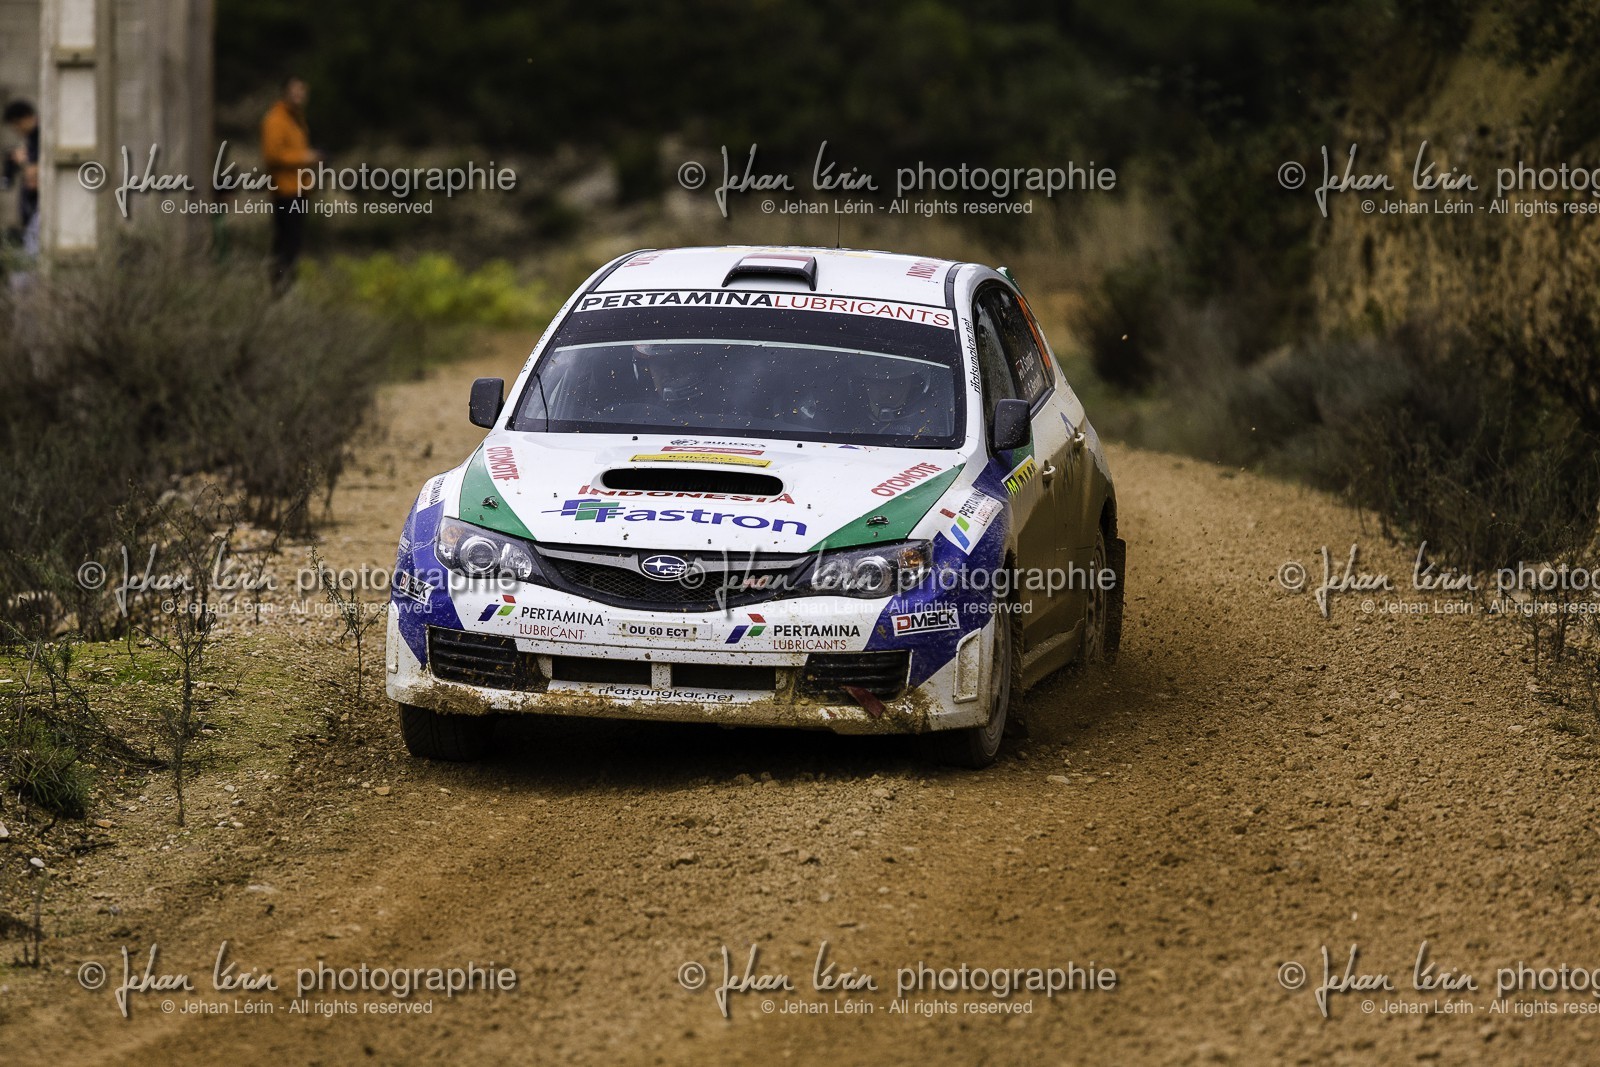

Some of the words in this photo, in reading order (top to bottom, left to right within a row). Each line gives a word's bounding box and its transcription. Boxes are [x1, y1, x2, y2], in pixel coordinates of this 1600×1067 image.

[486, 446, 520, 481] OTOMOTIF
[870, 461, 943, 497] OTOMOTIF
[578, 485, 795, 505] INDONESIA
[580, 506, 808, 536] Fastron
[521, 606, 605, 626] PERTAMINA
[519, 623, 585, 640] LUBRICANT
[629, 626, 646, 635] OU
[649, 627, 663, 636] 60
[666, 628, 689, 637] ECT
[773, 624, 861, 637] PERTAMINA
[773, 639, 847, 650] LUBRICANTS
